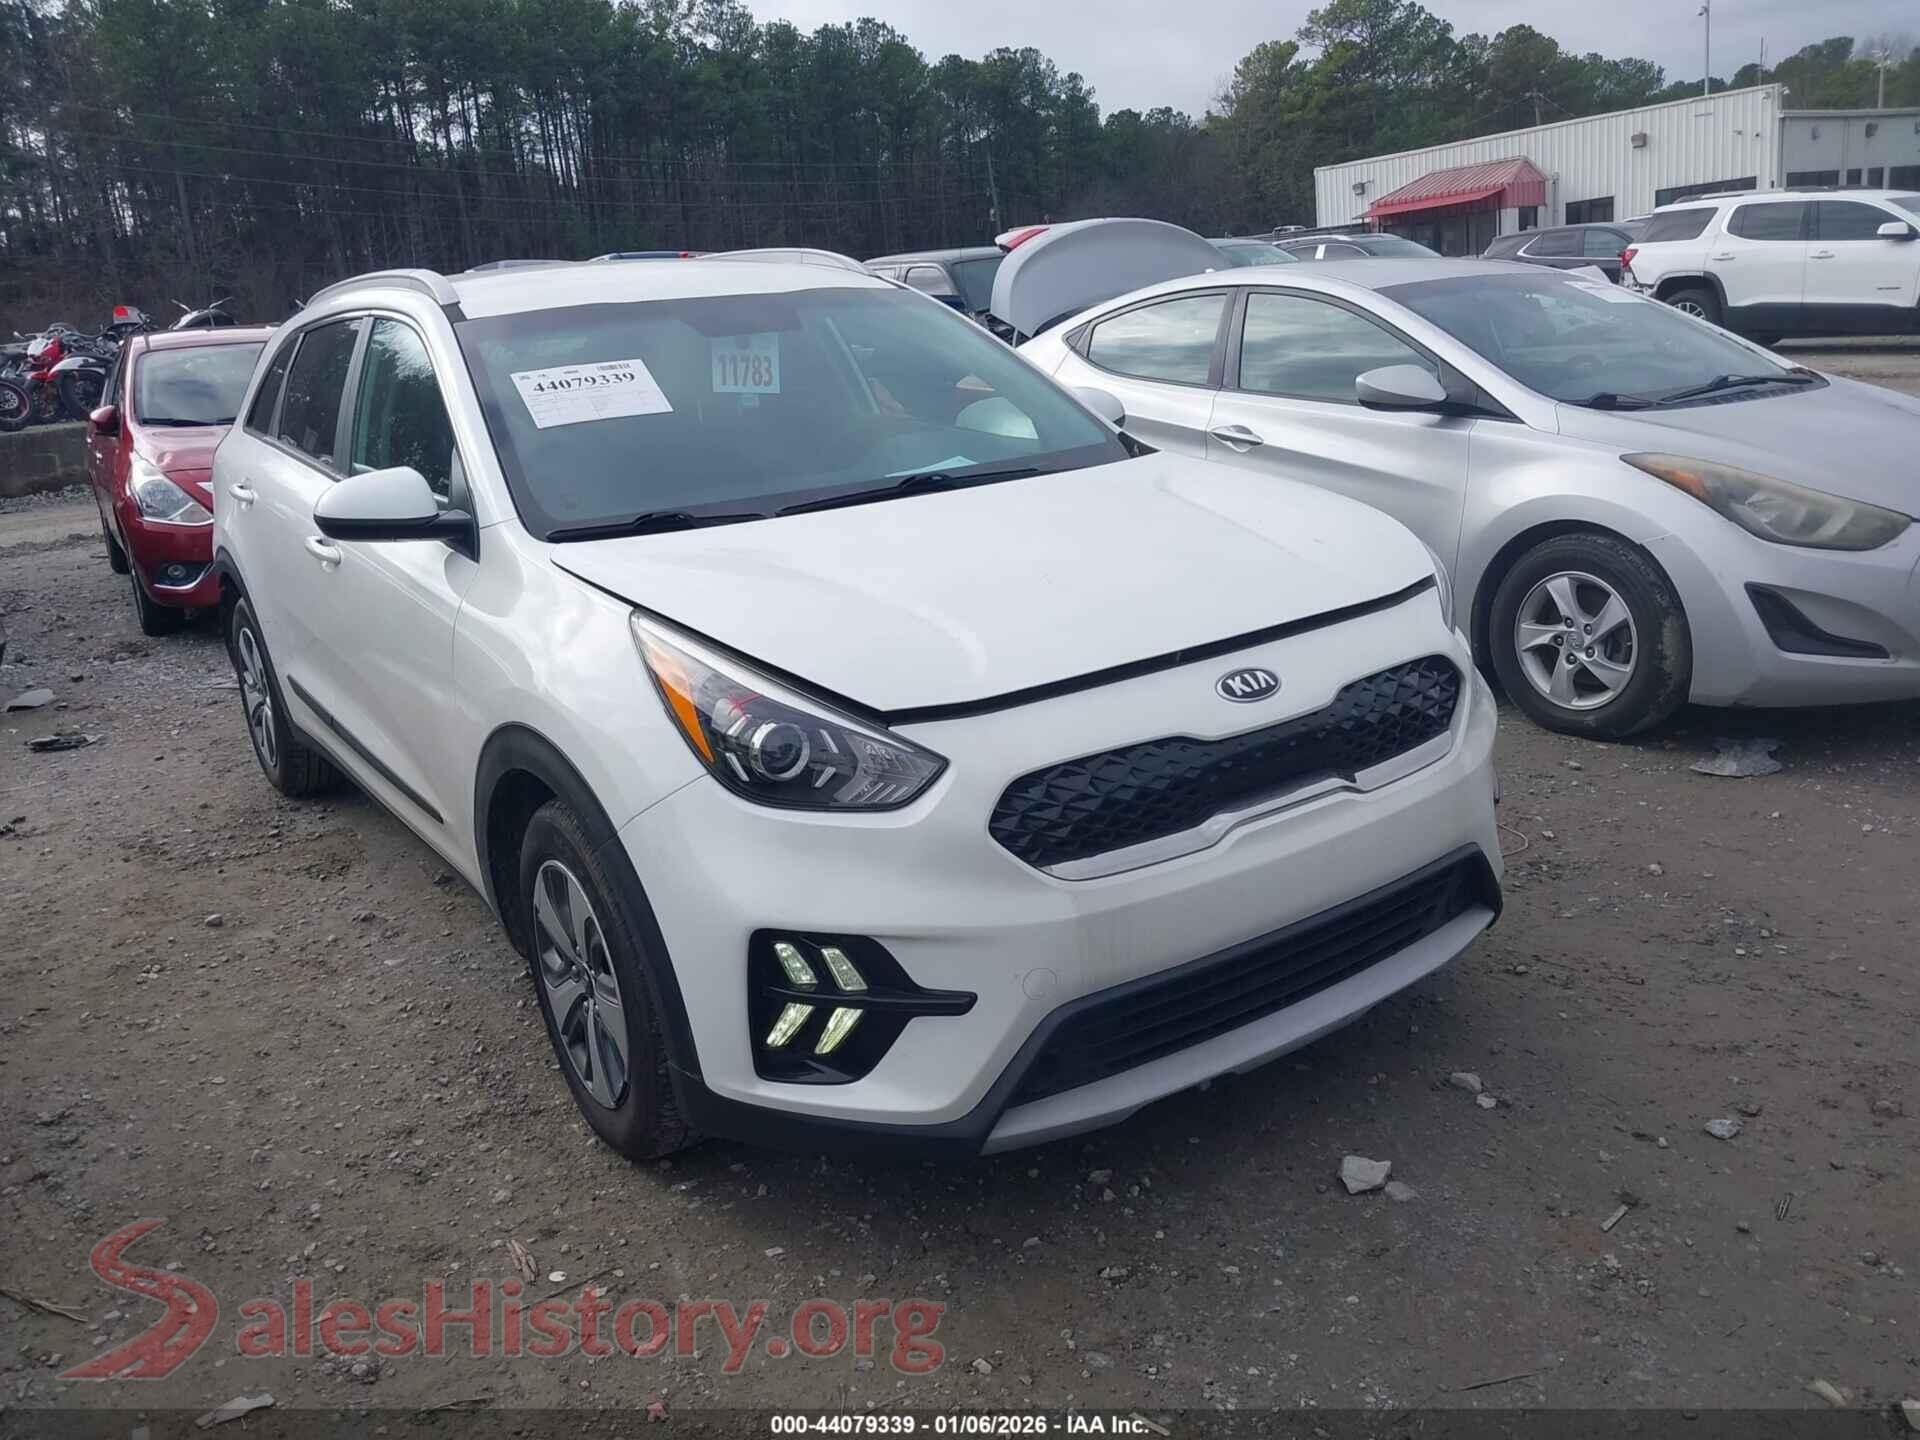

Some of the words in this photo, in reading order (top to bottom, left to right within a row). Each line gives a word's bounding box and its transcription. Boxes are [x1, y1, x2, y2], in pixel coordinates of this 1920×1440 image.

[533, 371, 636, 393] 44079339
[718, 353, 773, 387] 11783
[1225, 670, 1276, 696] KIA
